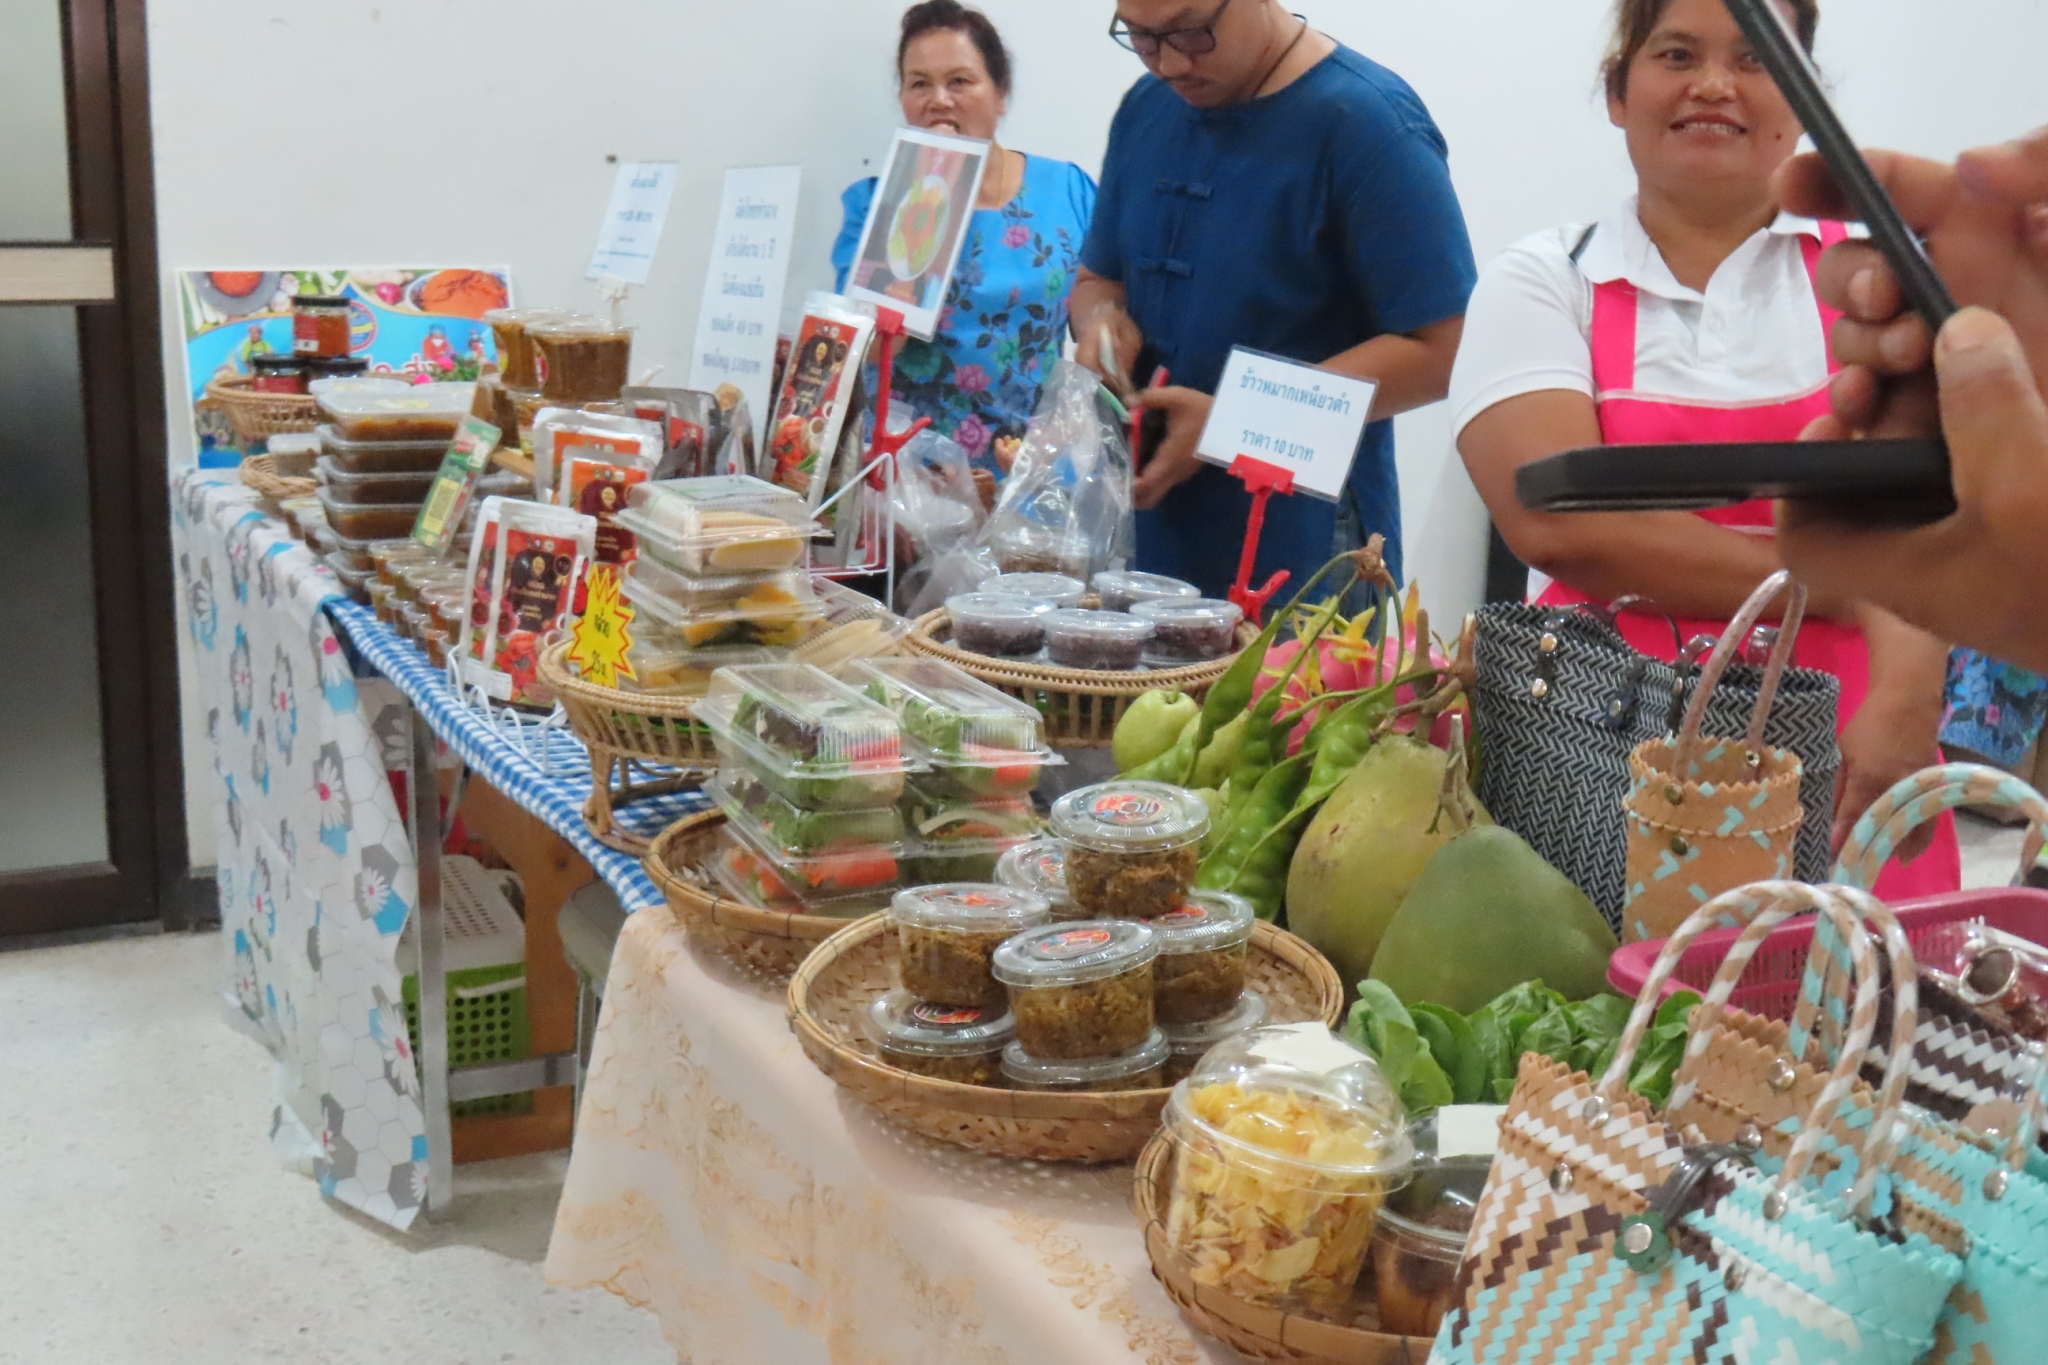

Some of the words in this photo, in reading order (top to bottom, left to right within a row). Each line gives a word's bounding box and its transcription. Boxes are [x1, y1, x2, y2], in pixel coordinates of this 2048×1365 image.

[1239, 366, 1351, 415] ข้าวหมากเหนียวดำ
[1241, 429, 1271, 450] ราคา
[1273, 438, 1286, 454] 10
[1288, 443, 1314, 463] บาท
